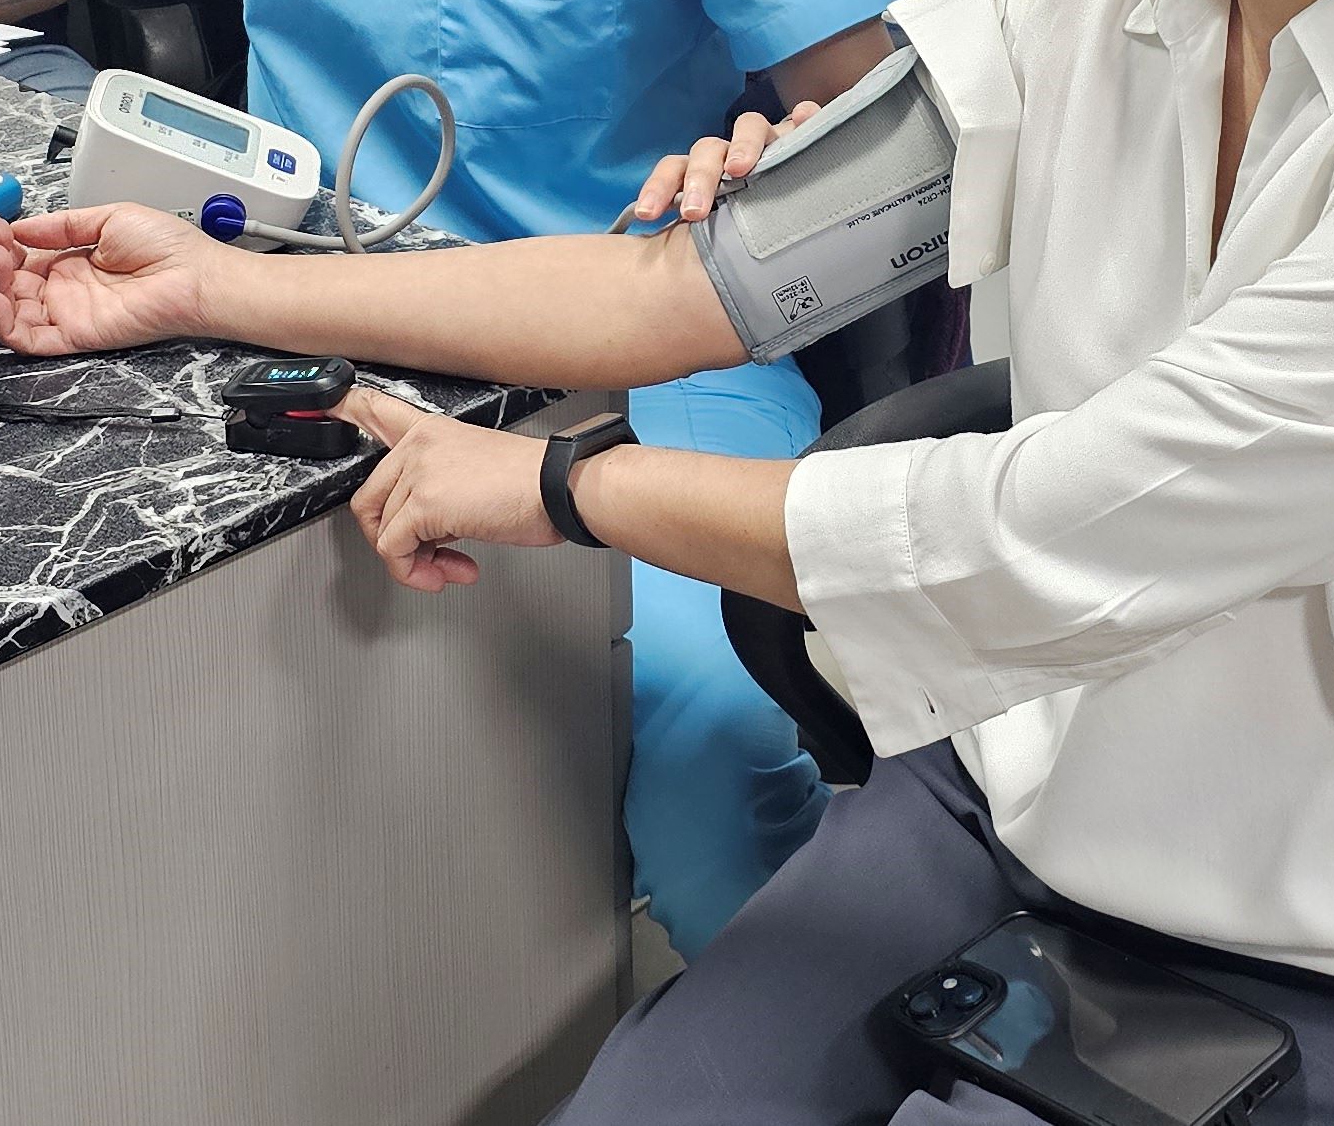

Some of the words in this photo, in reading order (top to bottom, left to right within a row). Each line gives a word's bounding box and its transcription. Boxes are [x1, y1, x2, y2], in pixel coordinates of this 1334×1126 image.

[915, 178, 942, 196] OMRON
[917, 185, 951, 206] EM-CR24
[871, 194, 916, 218] HEALTHCARE
